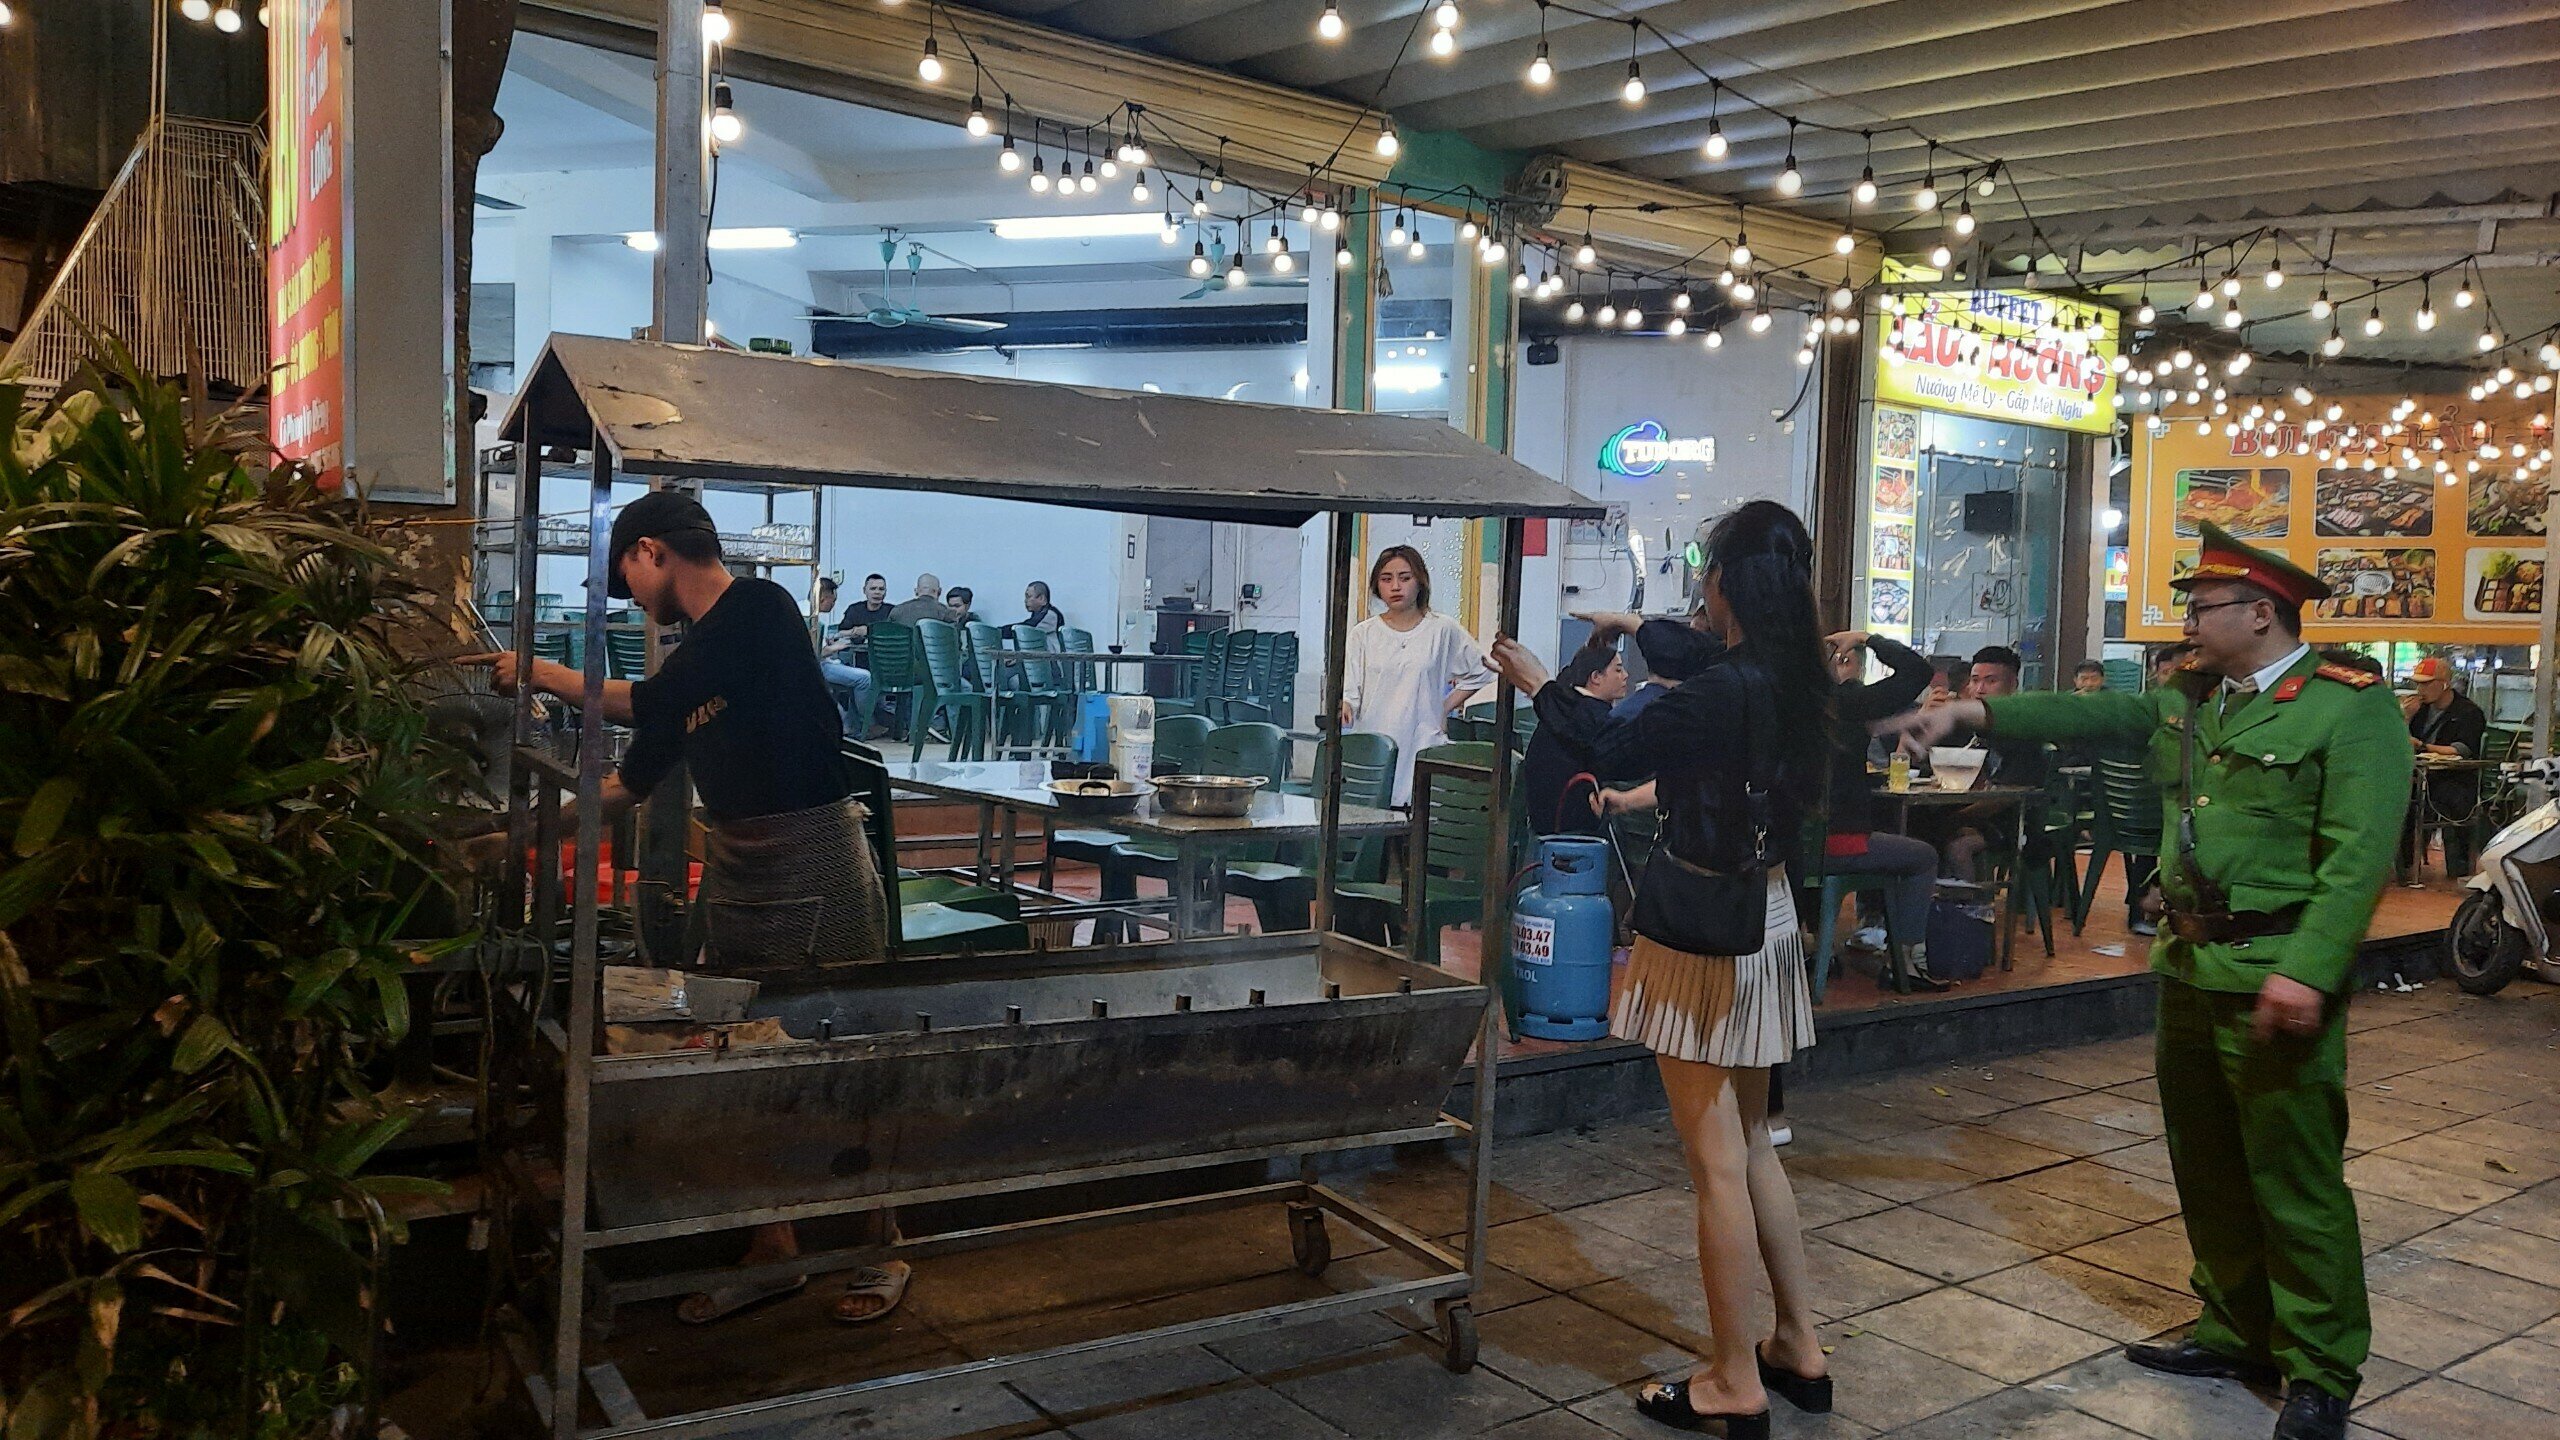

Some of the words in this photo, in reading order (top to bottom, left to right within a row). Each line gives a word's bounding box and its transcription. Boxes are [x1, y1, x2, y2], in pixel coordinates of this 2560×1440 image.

[1970, 289, 2042, 326] BUFFET
[1916, 374, 1957, 403] Nướng
[1960, 382, 1980, 402] Mê
[1982, 385, 1996, 408] Ly
[2007, 389, 2029, 412] Gắp
